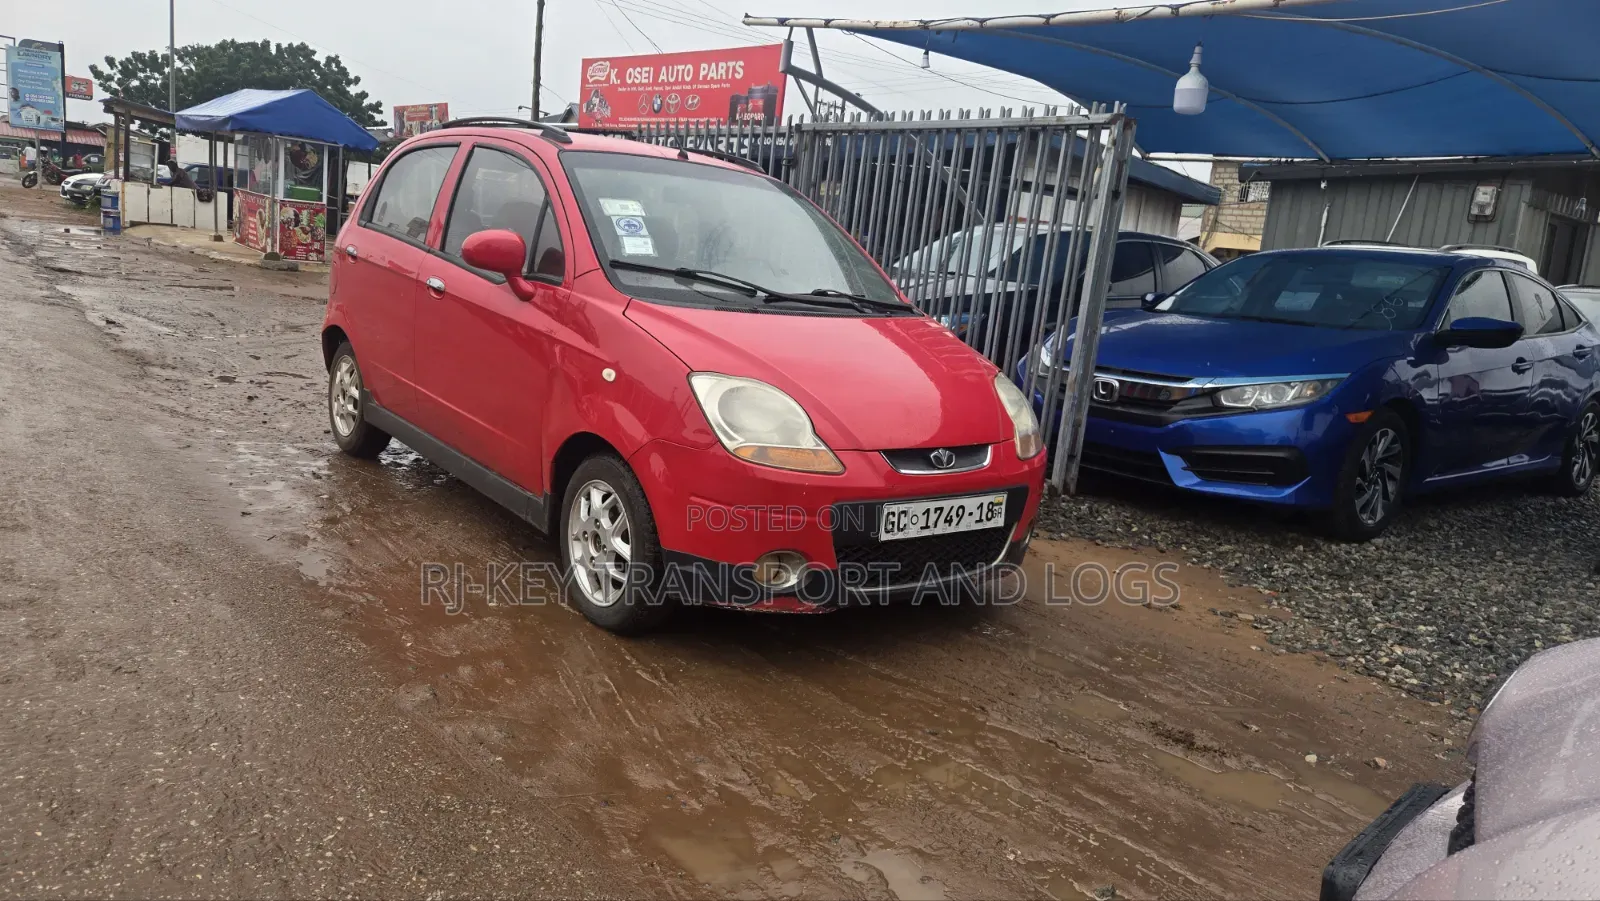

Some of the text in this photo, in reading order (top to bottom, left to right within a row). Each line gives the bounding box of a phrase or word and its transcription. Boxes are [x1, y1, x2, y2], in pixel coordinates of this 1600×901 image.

[17, 51, 52, 61] LAUNDRY
[610, 68, 621, 84] K.
[625, 66, 654, 84] OSEI
[658, 64, 693, 83] AUTO
[699, 60, 745, 81] PARTS
[70, 83, 87, 93] 95
[884, 501, 994, 533] GC 1749-18
